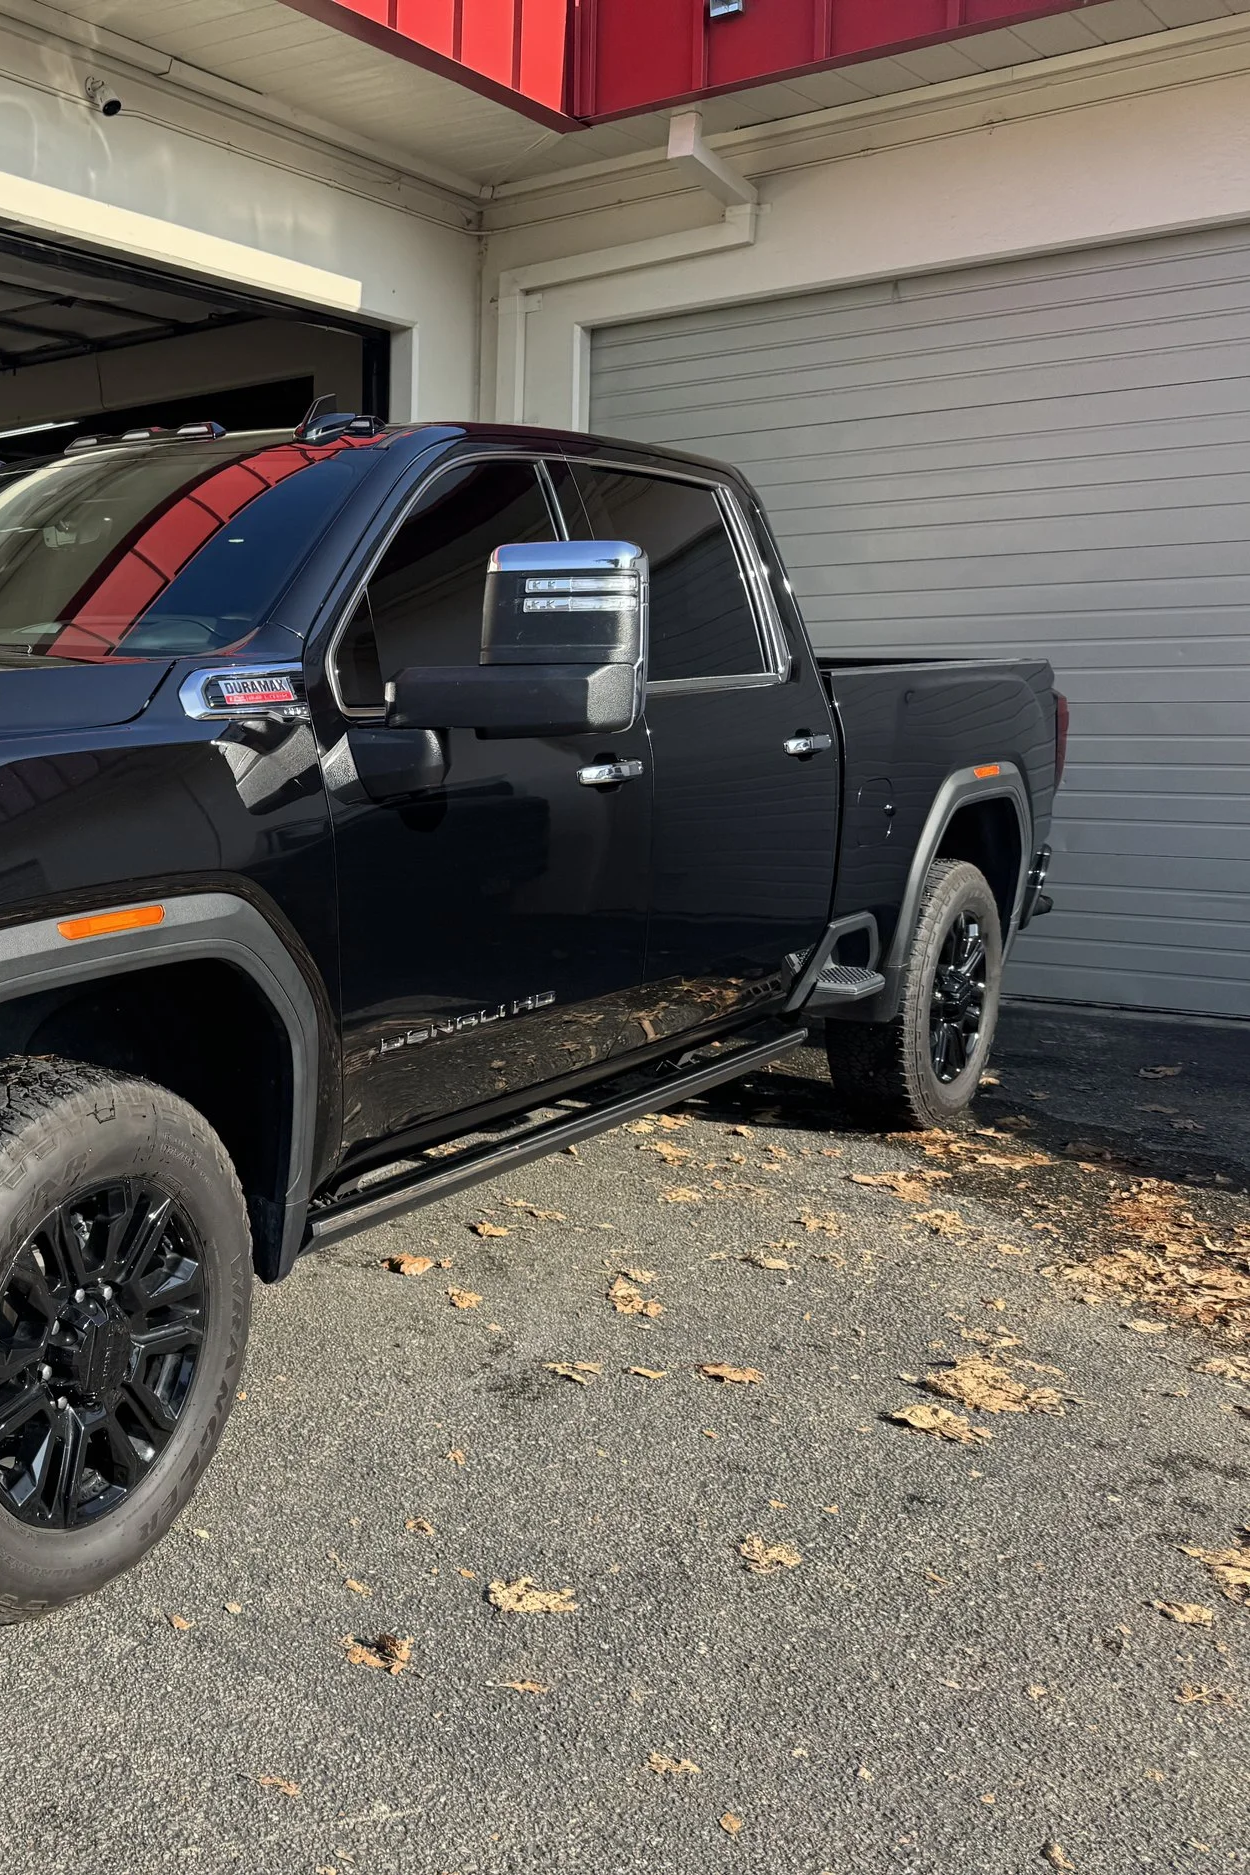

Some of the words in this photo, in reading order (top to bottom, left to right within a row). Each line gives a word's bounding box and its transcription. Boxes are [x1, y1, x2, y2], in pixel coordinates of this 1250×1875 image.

[224, 680, 286, 694] DURAMAX
[380, 1003, 506, 1054] DENALI
[138, 1252, 244, 1543] WRANGLER
